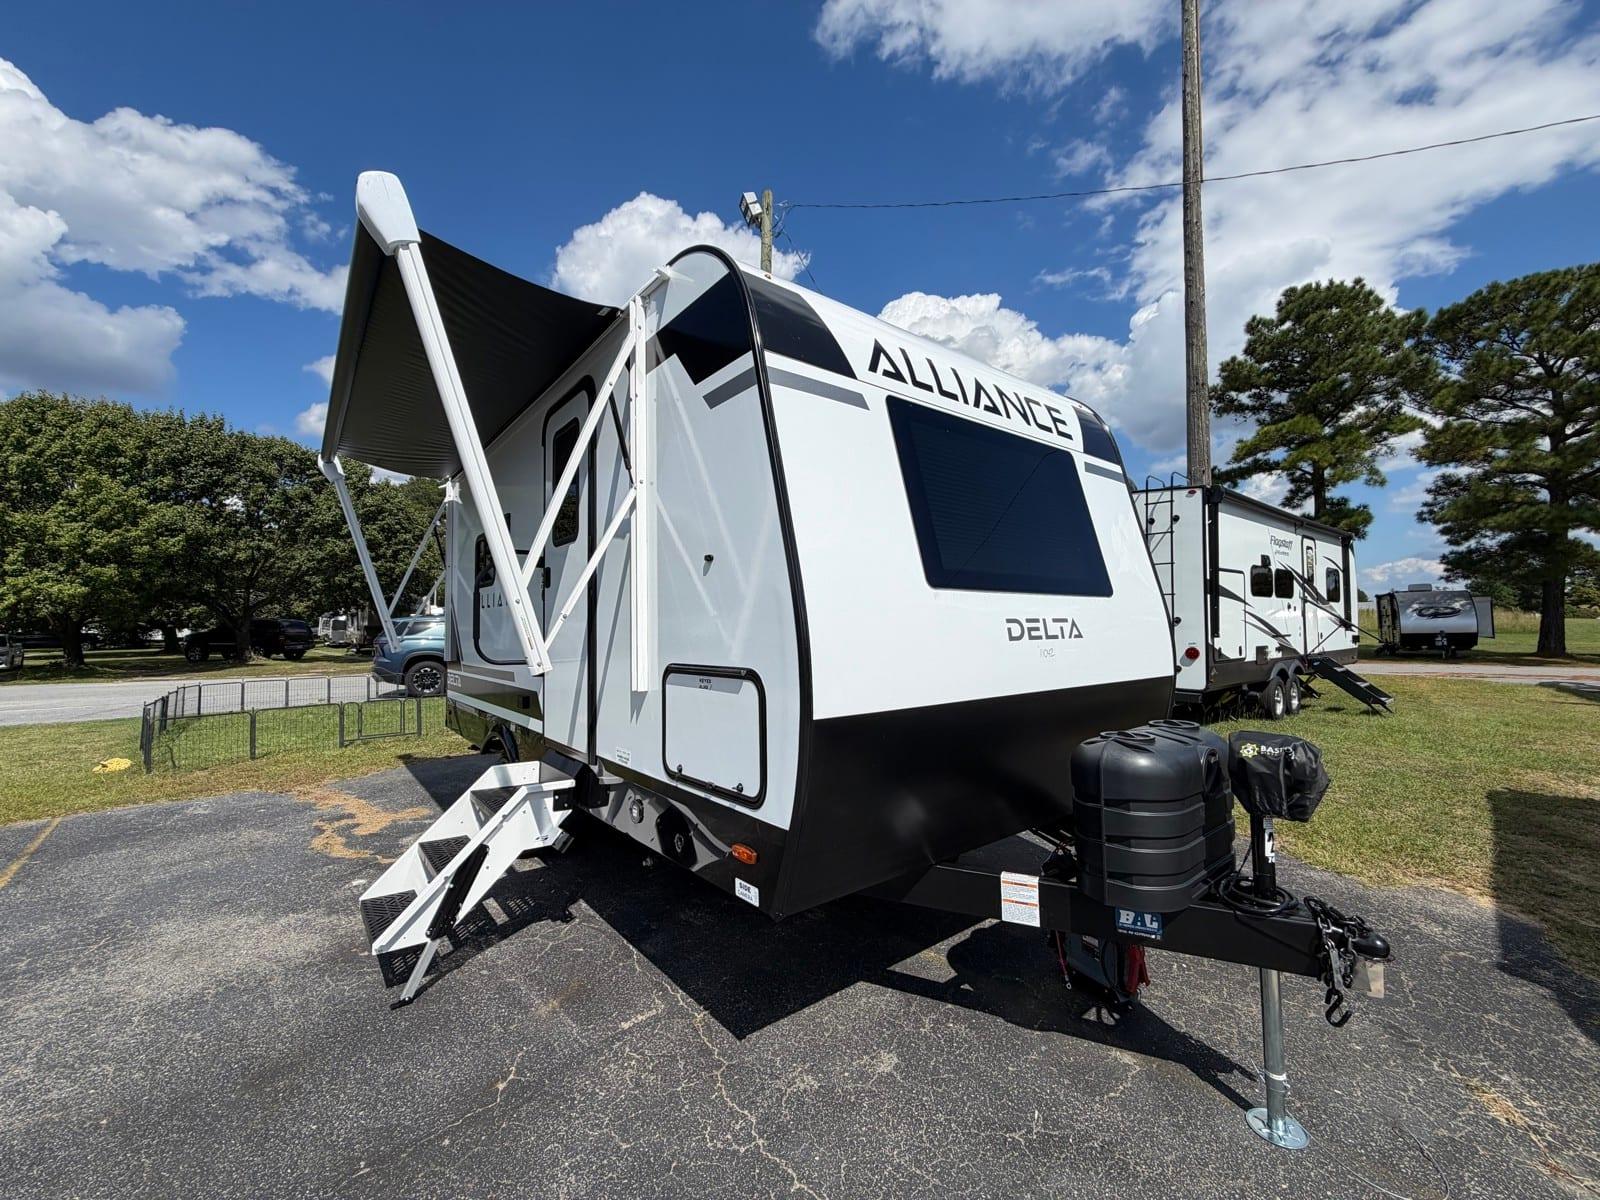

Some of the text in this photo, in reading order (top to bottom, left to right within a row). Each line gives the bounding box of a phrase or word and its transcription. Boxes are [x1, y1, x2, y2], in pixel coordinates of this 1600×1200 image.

[868, 338, 1074, 441] ALLIANCE
[1005, 617, 1084, 642] DELTA
[1119, 909, 1159, 929] BAL
